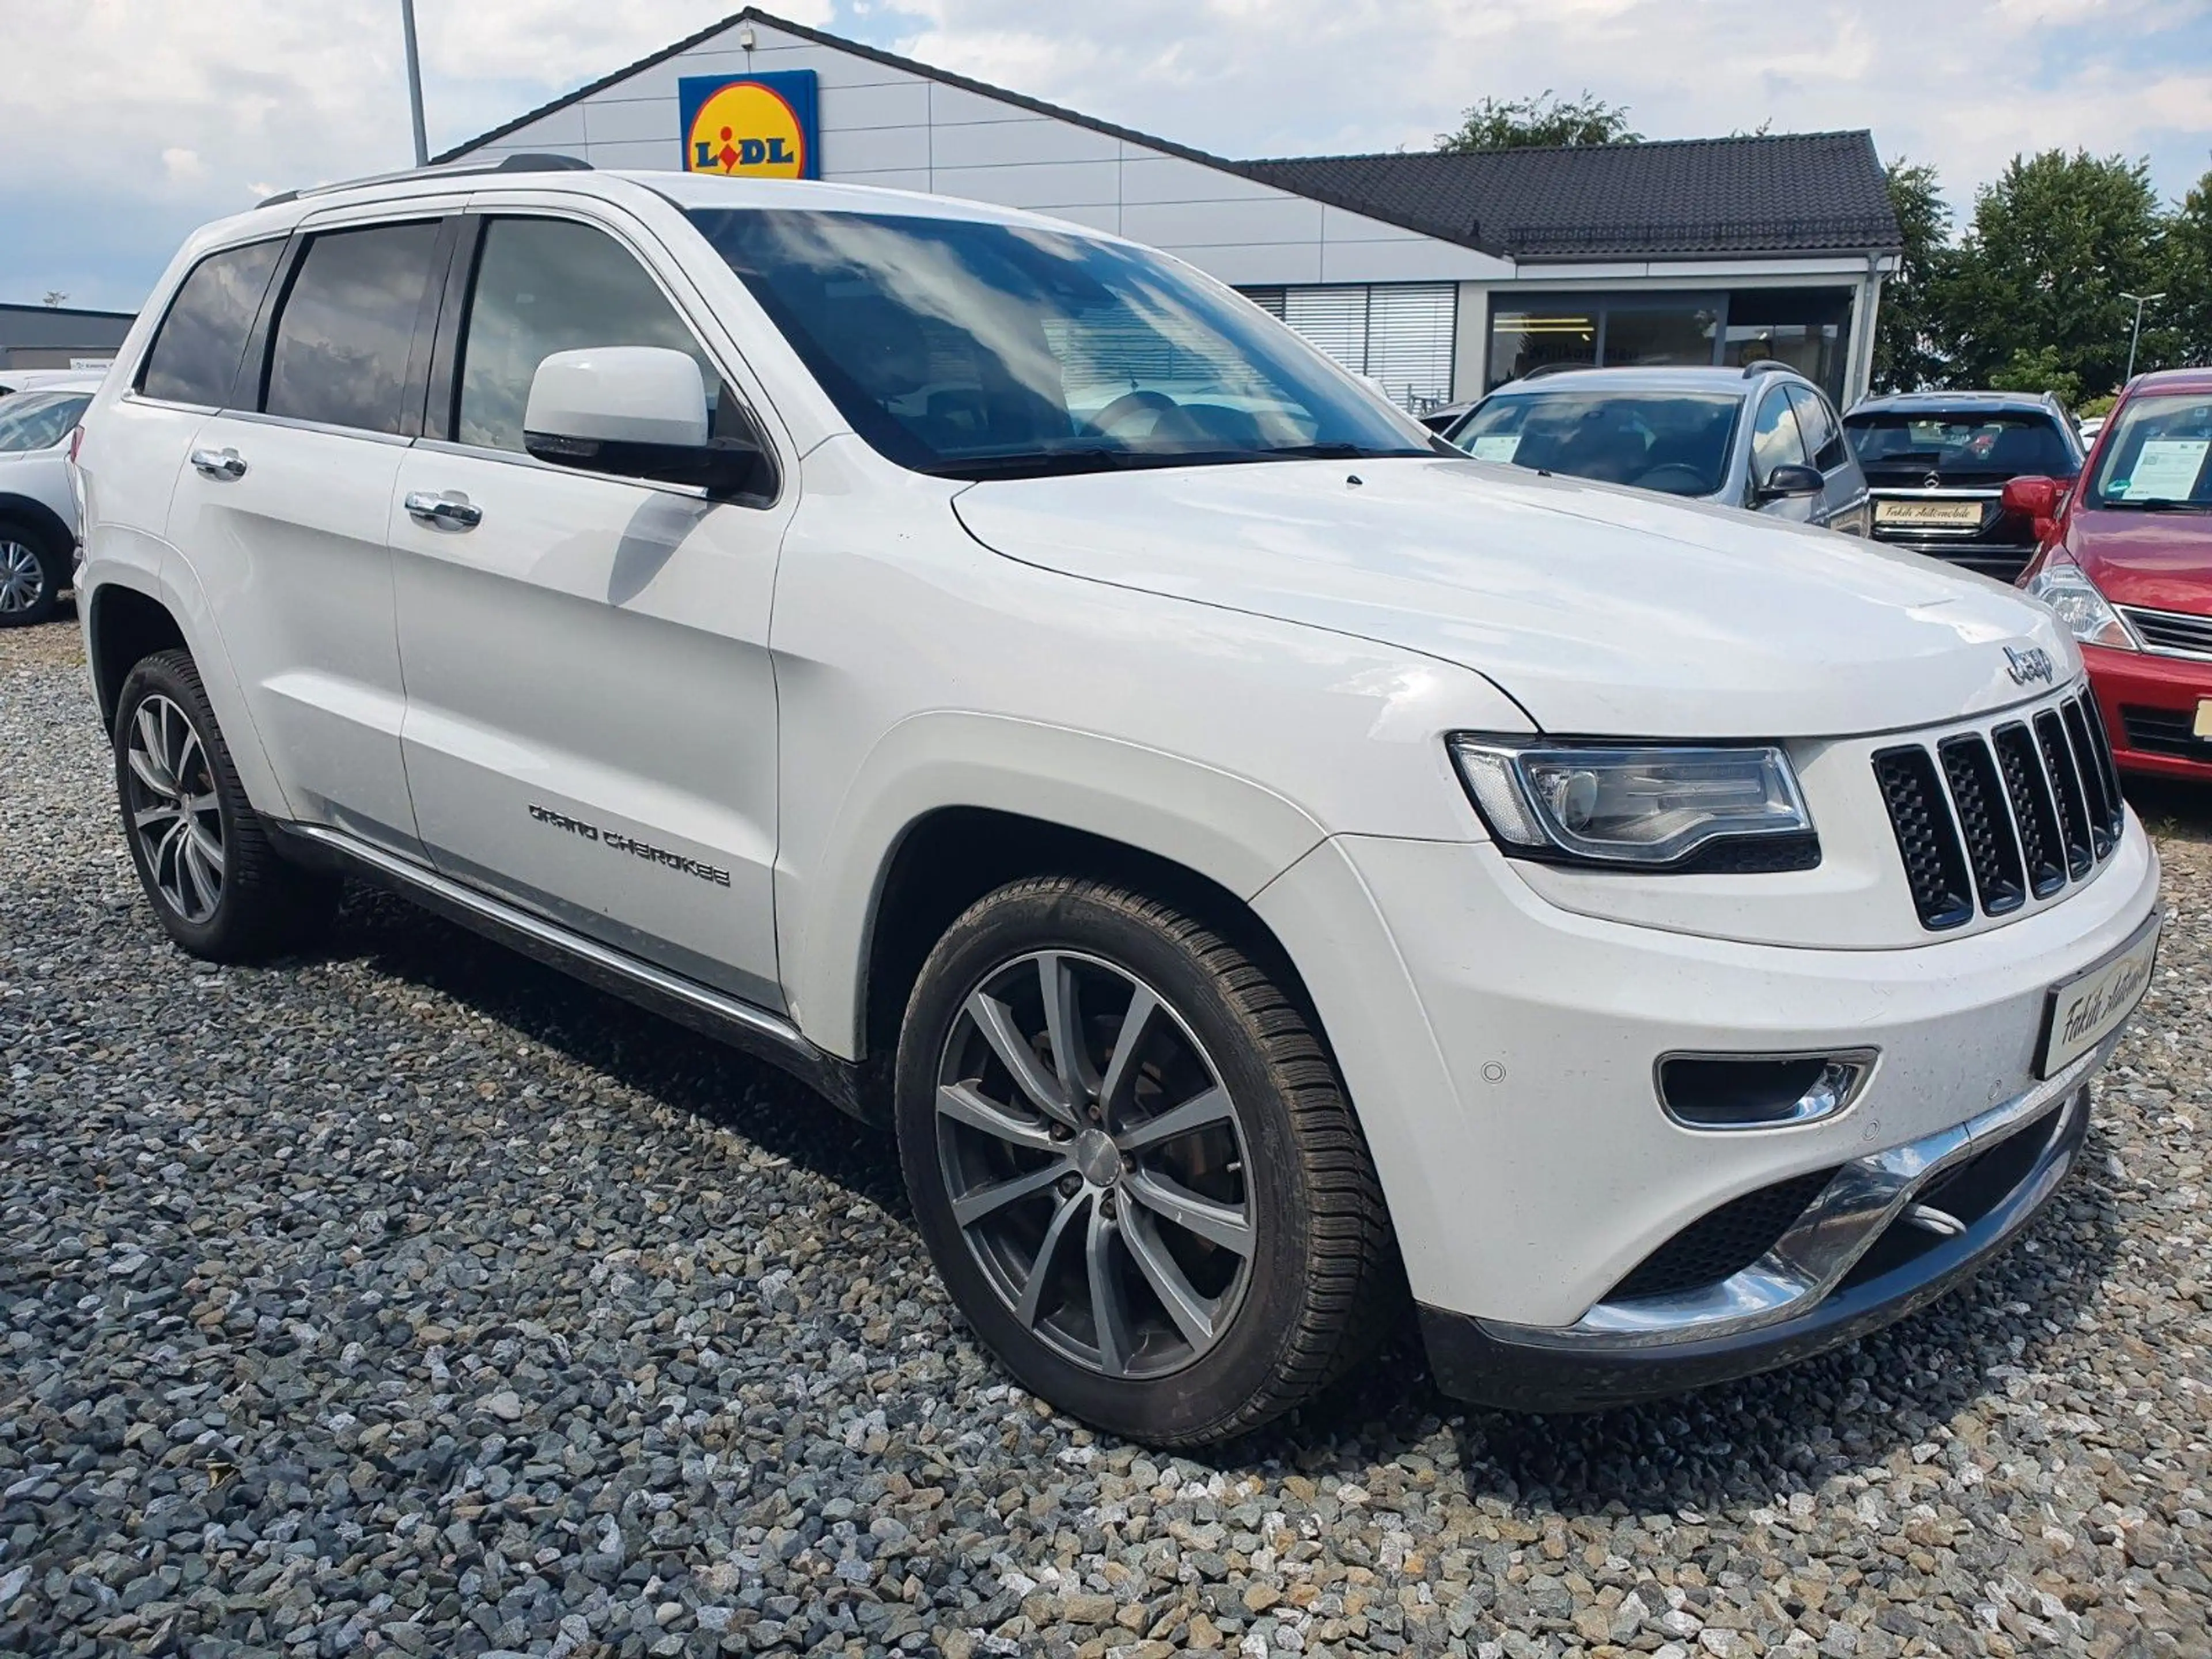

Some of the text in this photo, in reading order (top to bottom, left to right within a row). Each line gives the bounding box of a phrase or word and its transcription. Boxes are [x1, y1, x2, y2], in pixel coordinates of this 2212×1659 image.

[2002, 645, 2052, 686] Jeep
[528, 802, 731, 888] GRAND CHEROKEE
